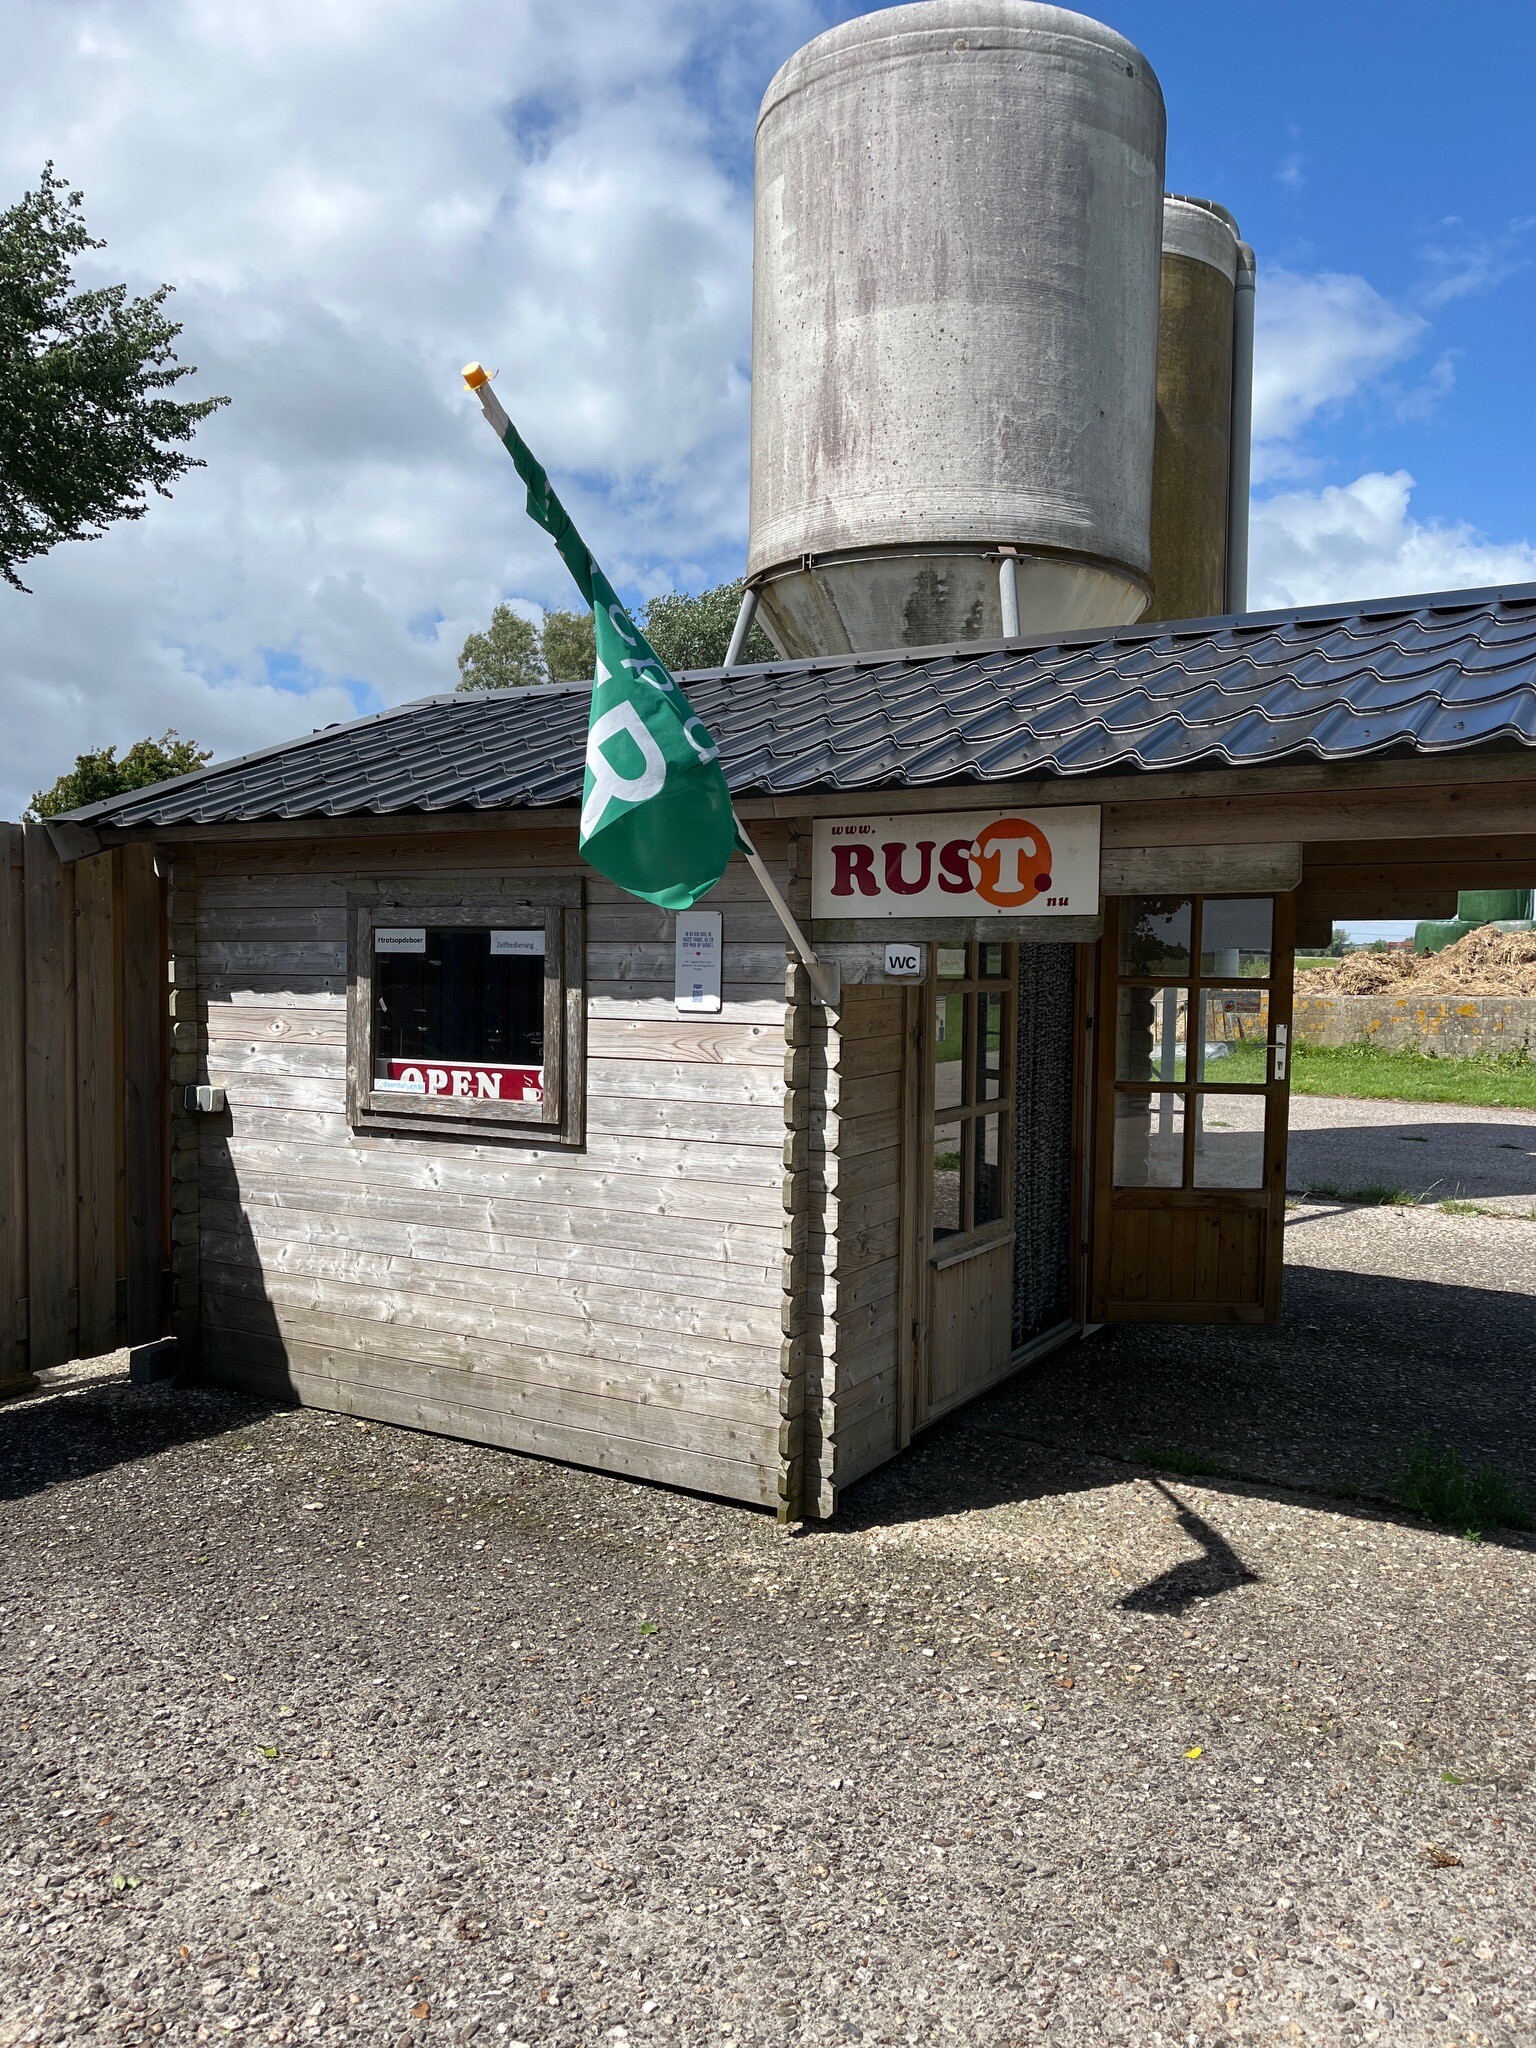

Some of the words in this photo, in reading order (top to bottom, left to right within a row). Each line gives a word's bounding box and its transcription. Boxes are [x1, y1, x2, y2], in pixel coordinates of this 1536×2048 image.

[831, 824, 876, 835] www.
[377, 937, 424, 945] #trotsopdeboer
[496, 941, 535, 950] Zelfbediening
[888, 956, 917, 969] WC
[400, 1067, 503, 1099] OPEN
